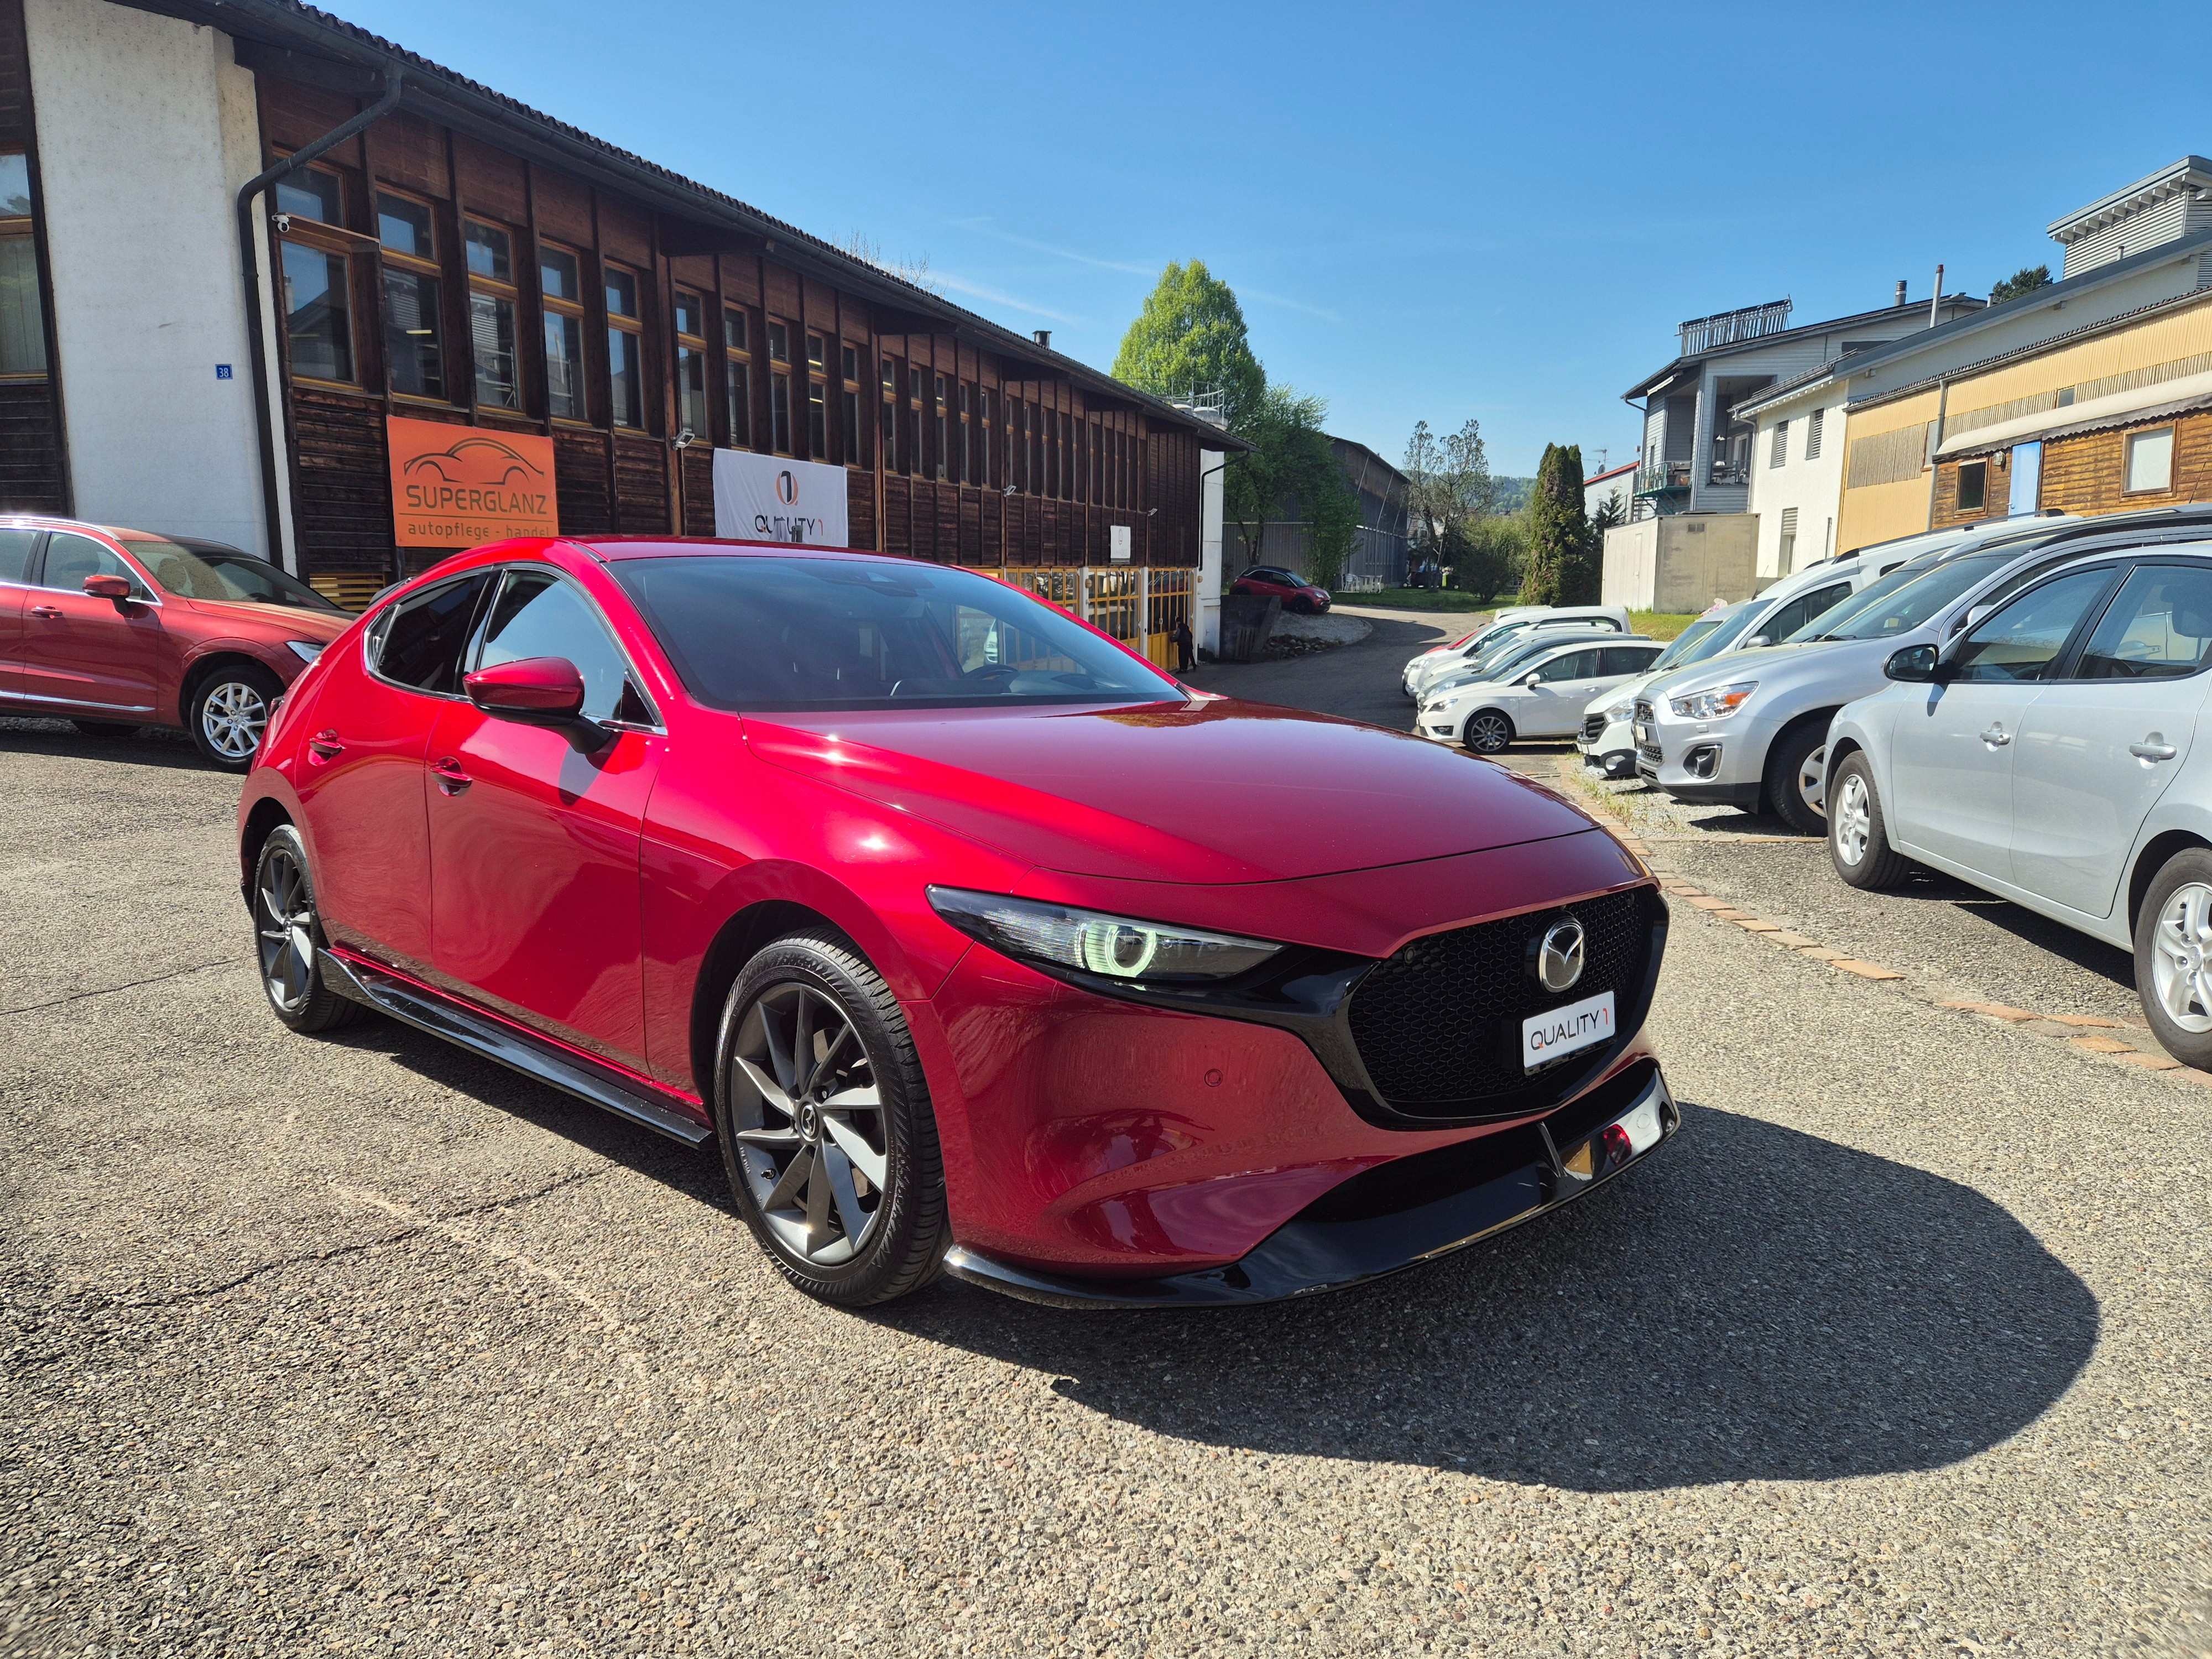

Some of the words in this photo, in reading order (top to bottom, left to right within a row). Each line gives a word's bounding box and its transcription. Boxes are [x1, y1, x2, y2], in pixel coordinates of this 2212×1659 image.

[218, 367, 229, 377] 38
[406, 485, 547, 515] SUPERGLANZ
[408, 521, 489, 540] autopflege
[506, 525, 549, 538] handel
[818, 519, 823, 536] 1
[1531, 1010, 1599, 1051] QUALITY
[1603, 1008, 1608, 1025] 1
